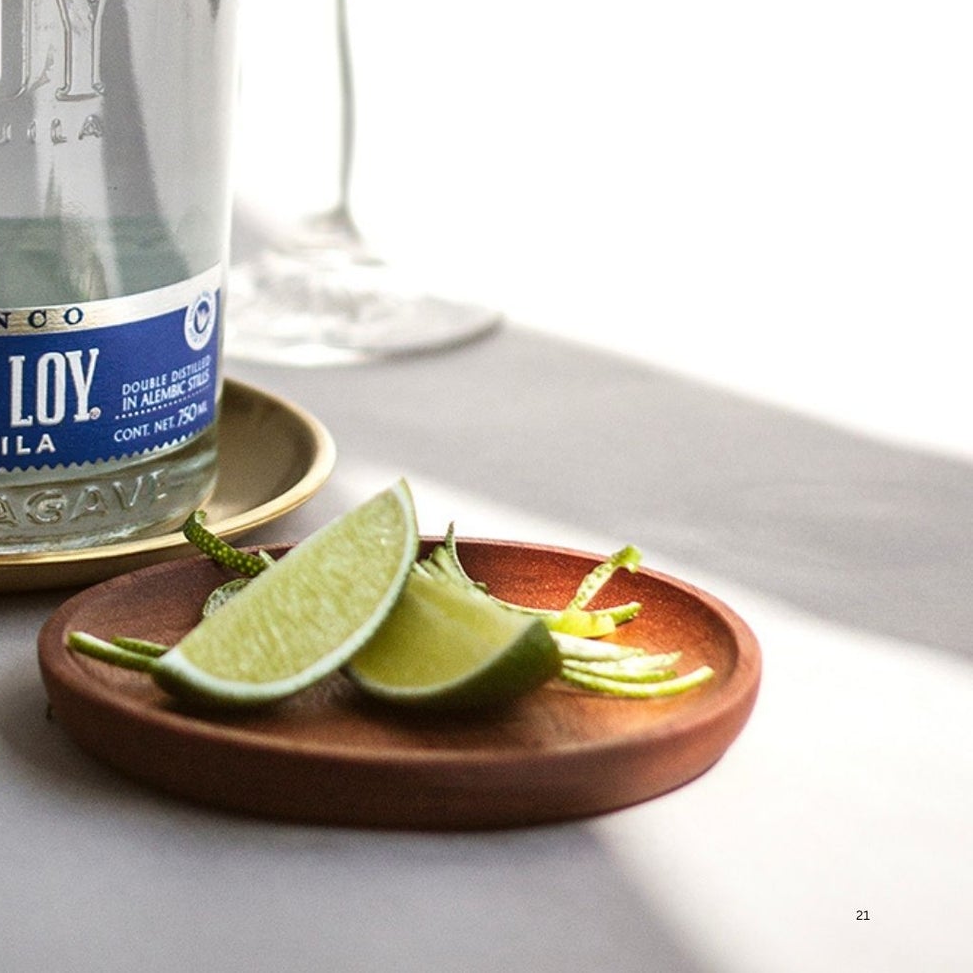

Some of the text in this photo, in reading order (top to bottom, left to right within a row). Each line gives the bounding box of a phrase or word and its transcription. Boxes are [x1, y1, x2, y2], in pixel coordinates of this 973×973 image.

[122, 354, 212, 396] DOUBLE DISTILLED
[123, 368, 210, 412] IN ALEMBIC STILLS
[114, 423, 150, 443] CONT.
